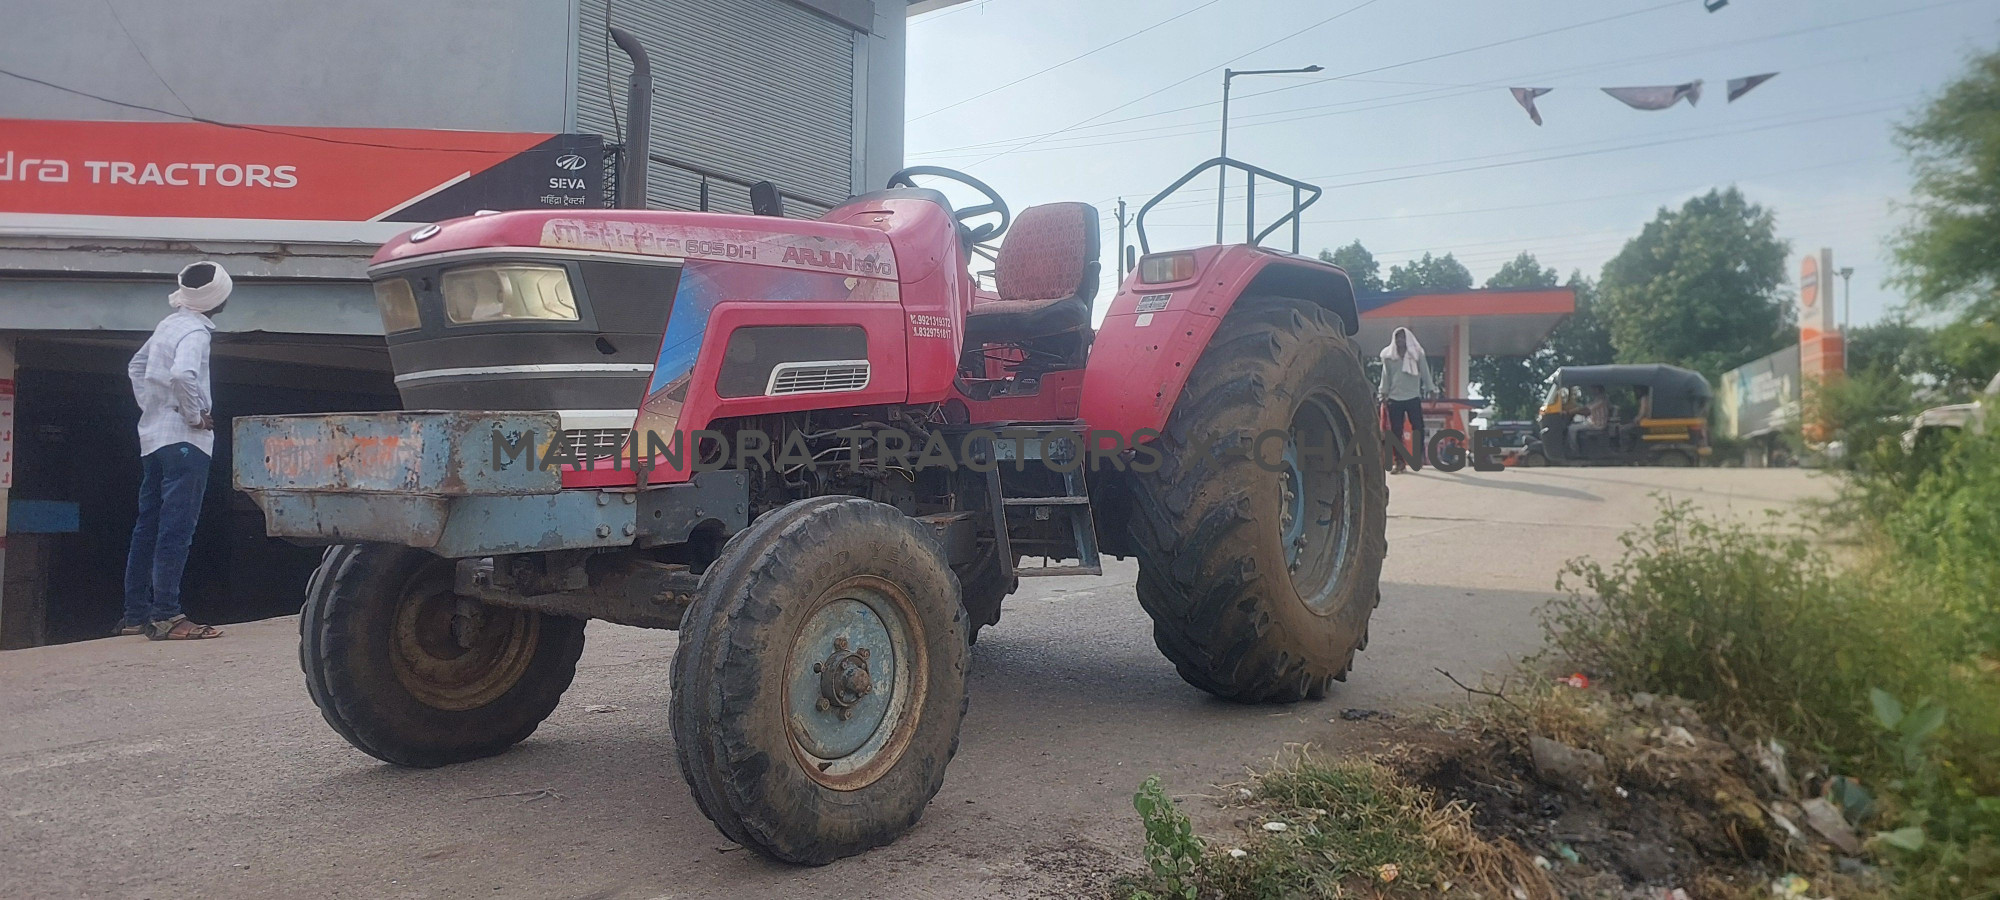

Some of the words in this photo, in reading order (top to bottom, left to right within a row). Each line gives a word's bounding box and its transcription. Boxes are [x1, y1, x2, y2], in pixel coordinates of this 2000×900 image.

[84, 161, 298, 189] TRACTORS
[549, 177, 586, 190] SEVA
[781, 246, 853, 271] ARJUN
